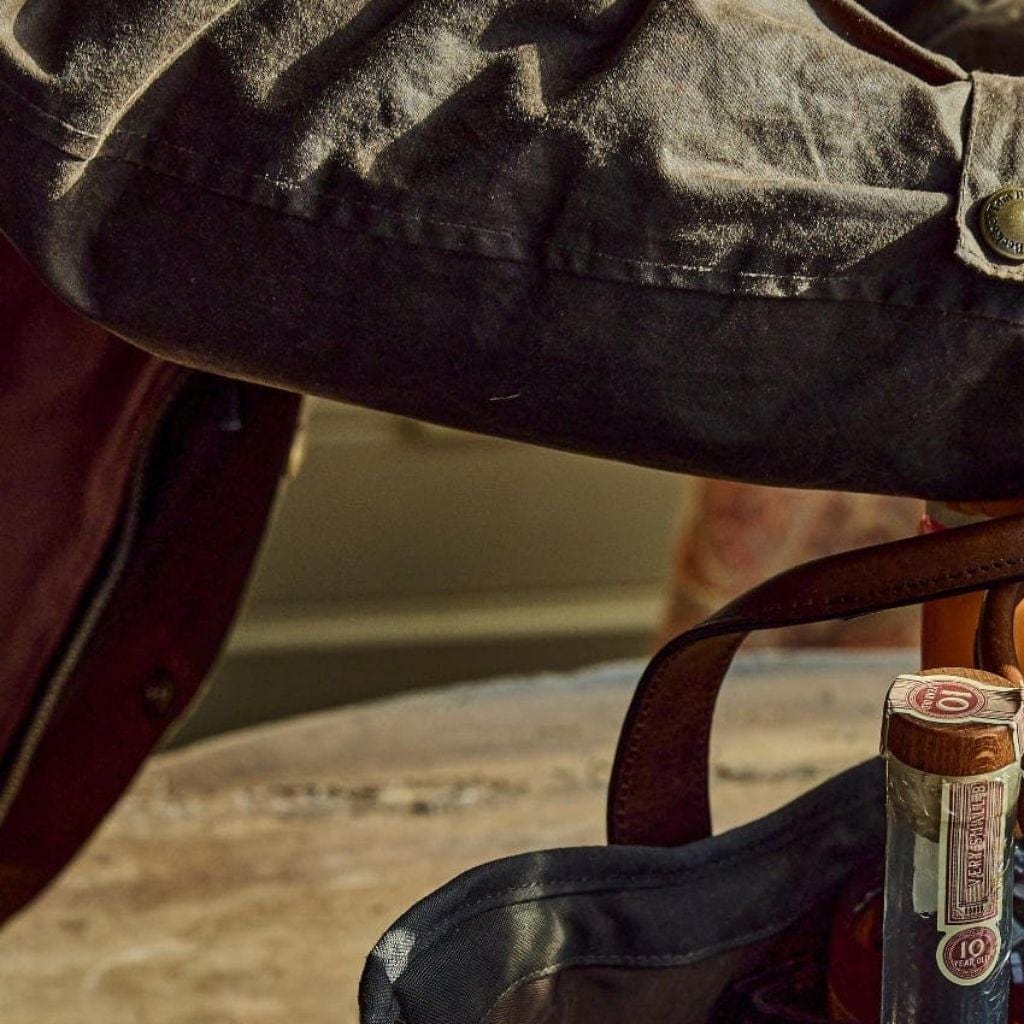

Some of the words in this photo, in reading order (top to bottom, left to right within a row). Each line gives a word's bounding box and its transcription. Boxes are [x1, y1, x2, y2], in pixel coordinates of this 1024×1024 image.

[938, 689, 972, 711] 10
[968, 799, 985, 846] SMALL
[966, 850, 983, 888] VERY
[960, 939, 985, 959] 10
